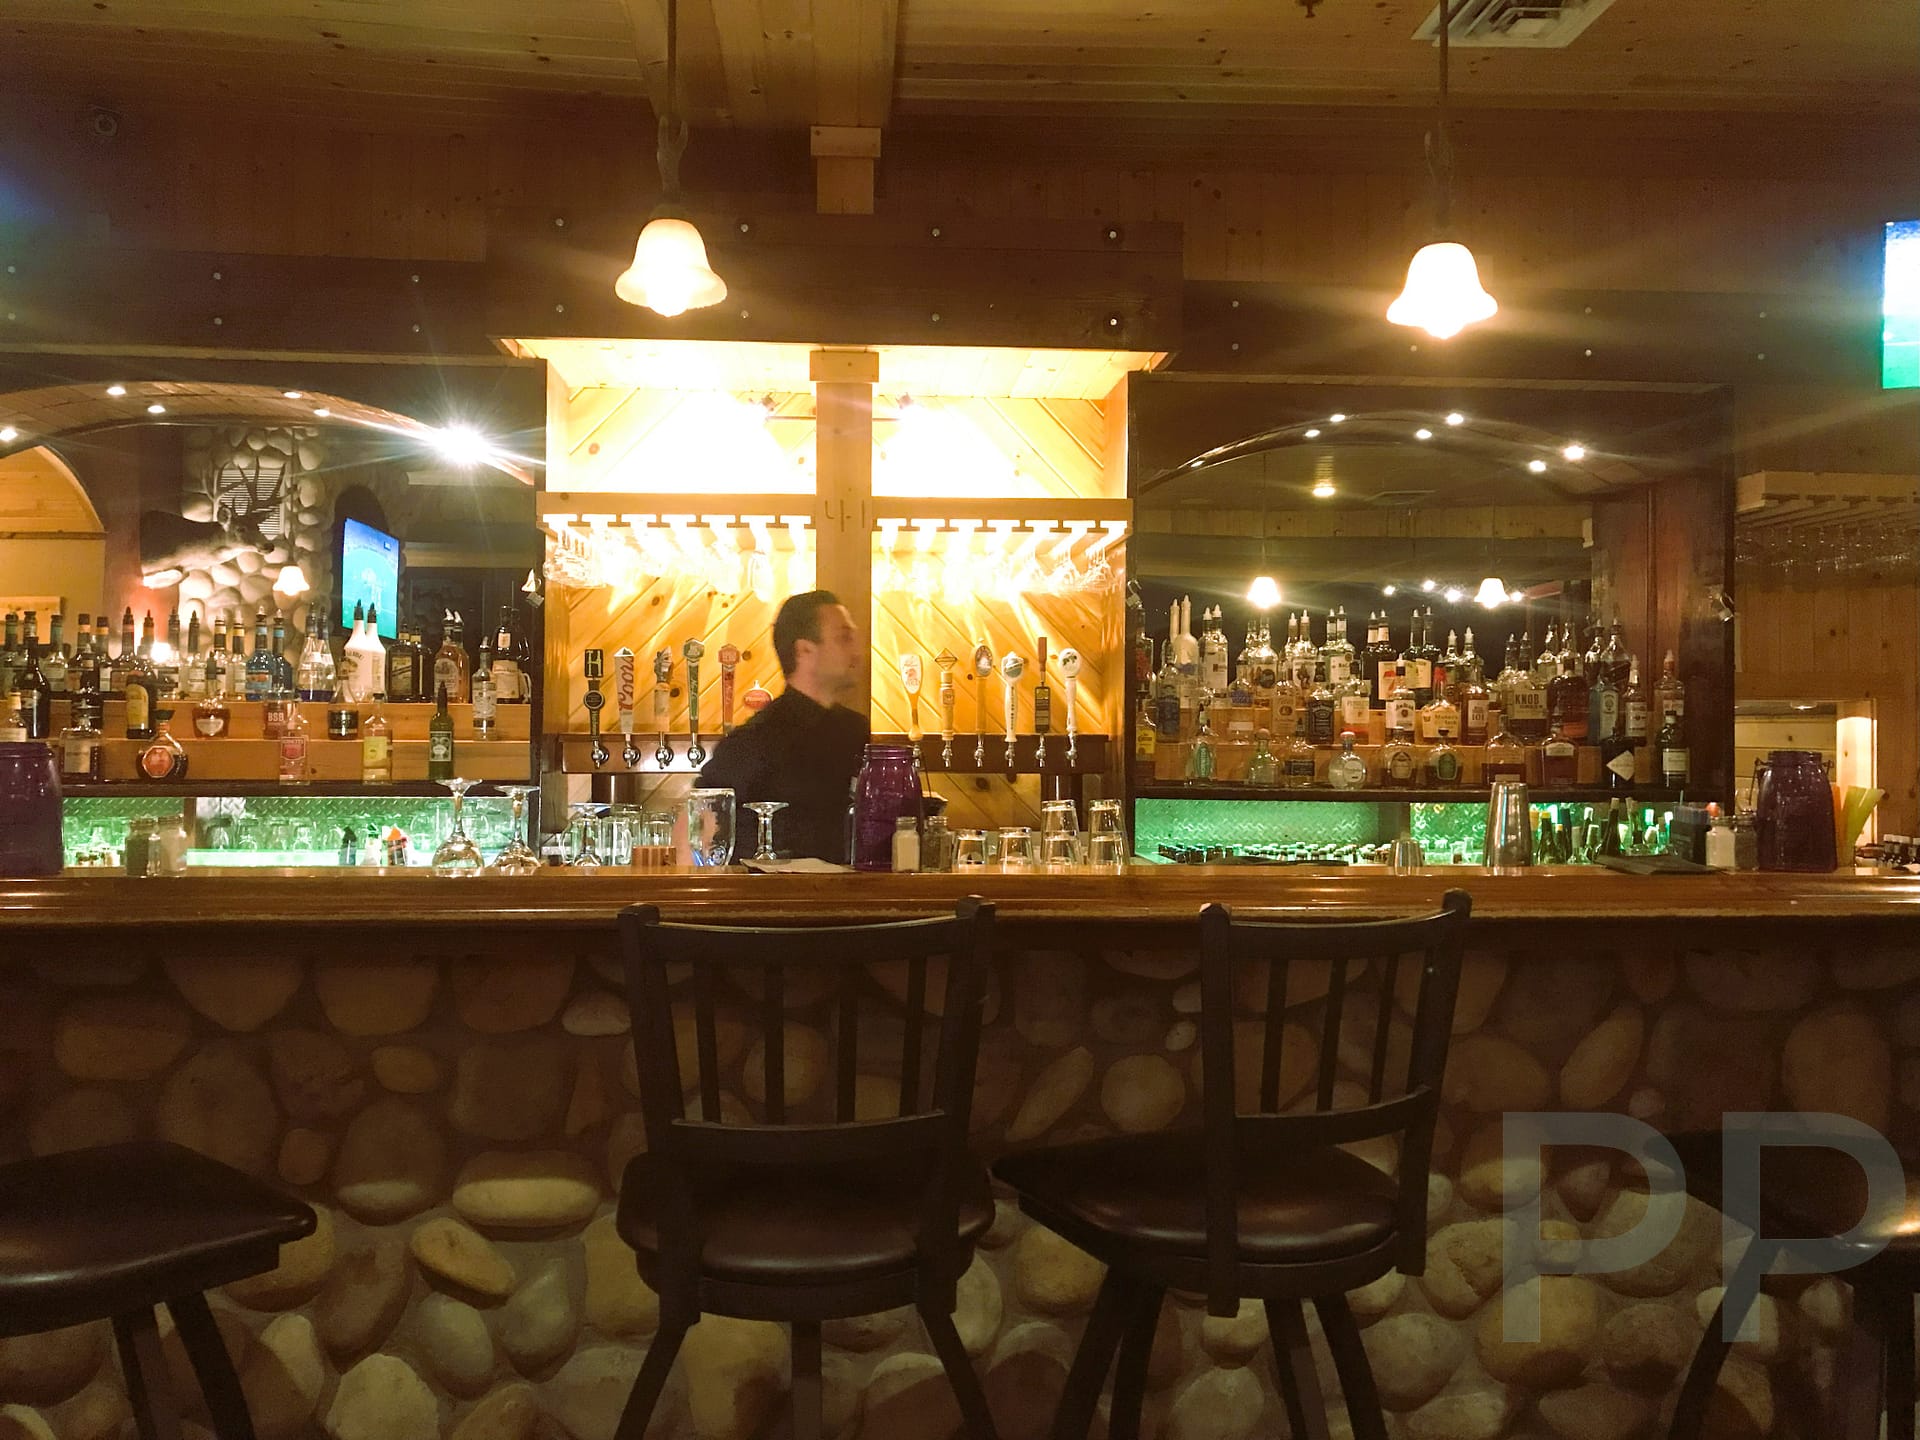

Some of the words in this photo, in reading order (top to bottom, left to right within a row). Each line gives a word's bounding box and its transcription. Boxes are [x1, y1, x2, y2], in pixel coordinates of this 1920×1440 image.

[1515, 693, 1540, 705] KNOB
[267, 711, 285, 722] BSB
[1472, 713, 1485, 721] 101
